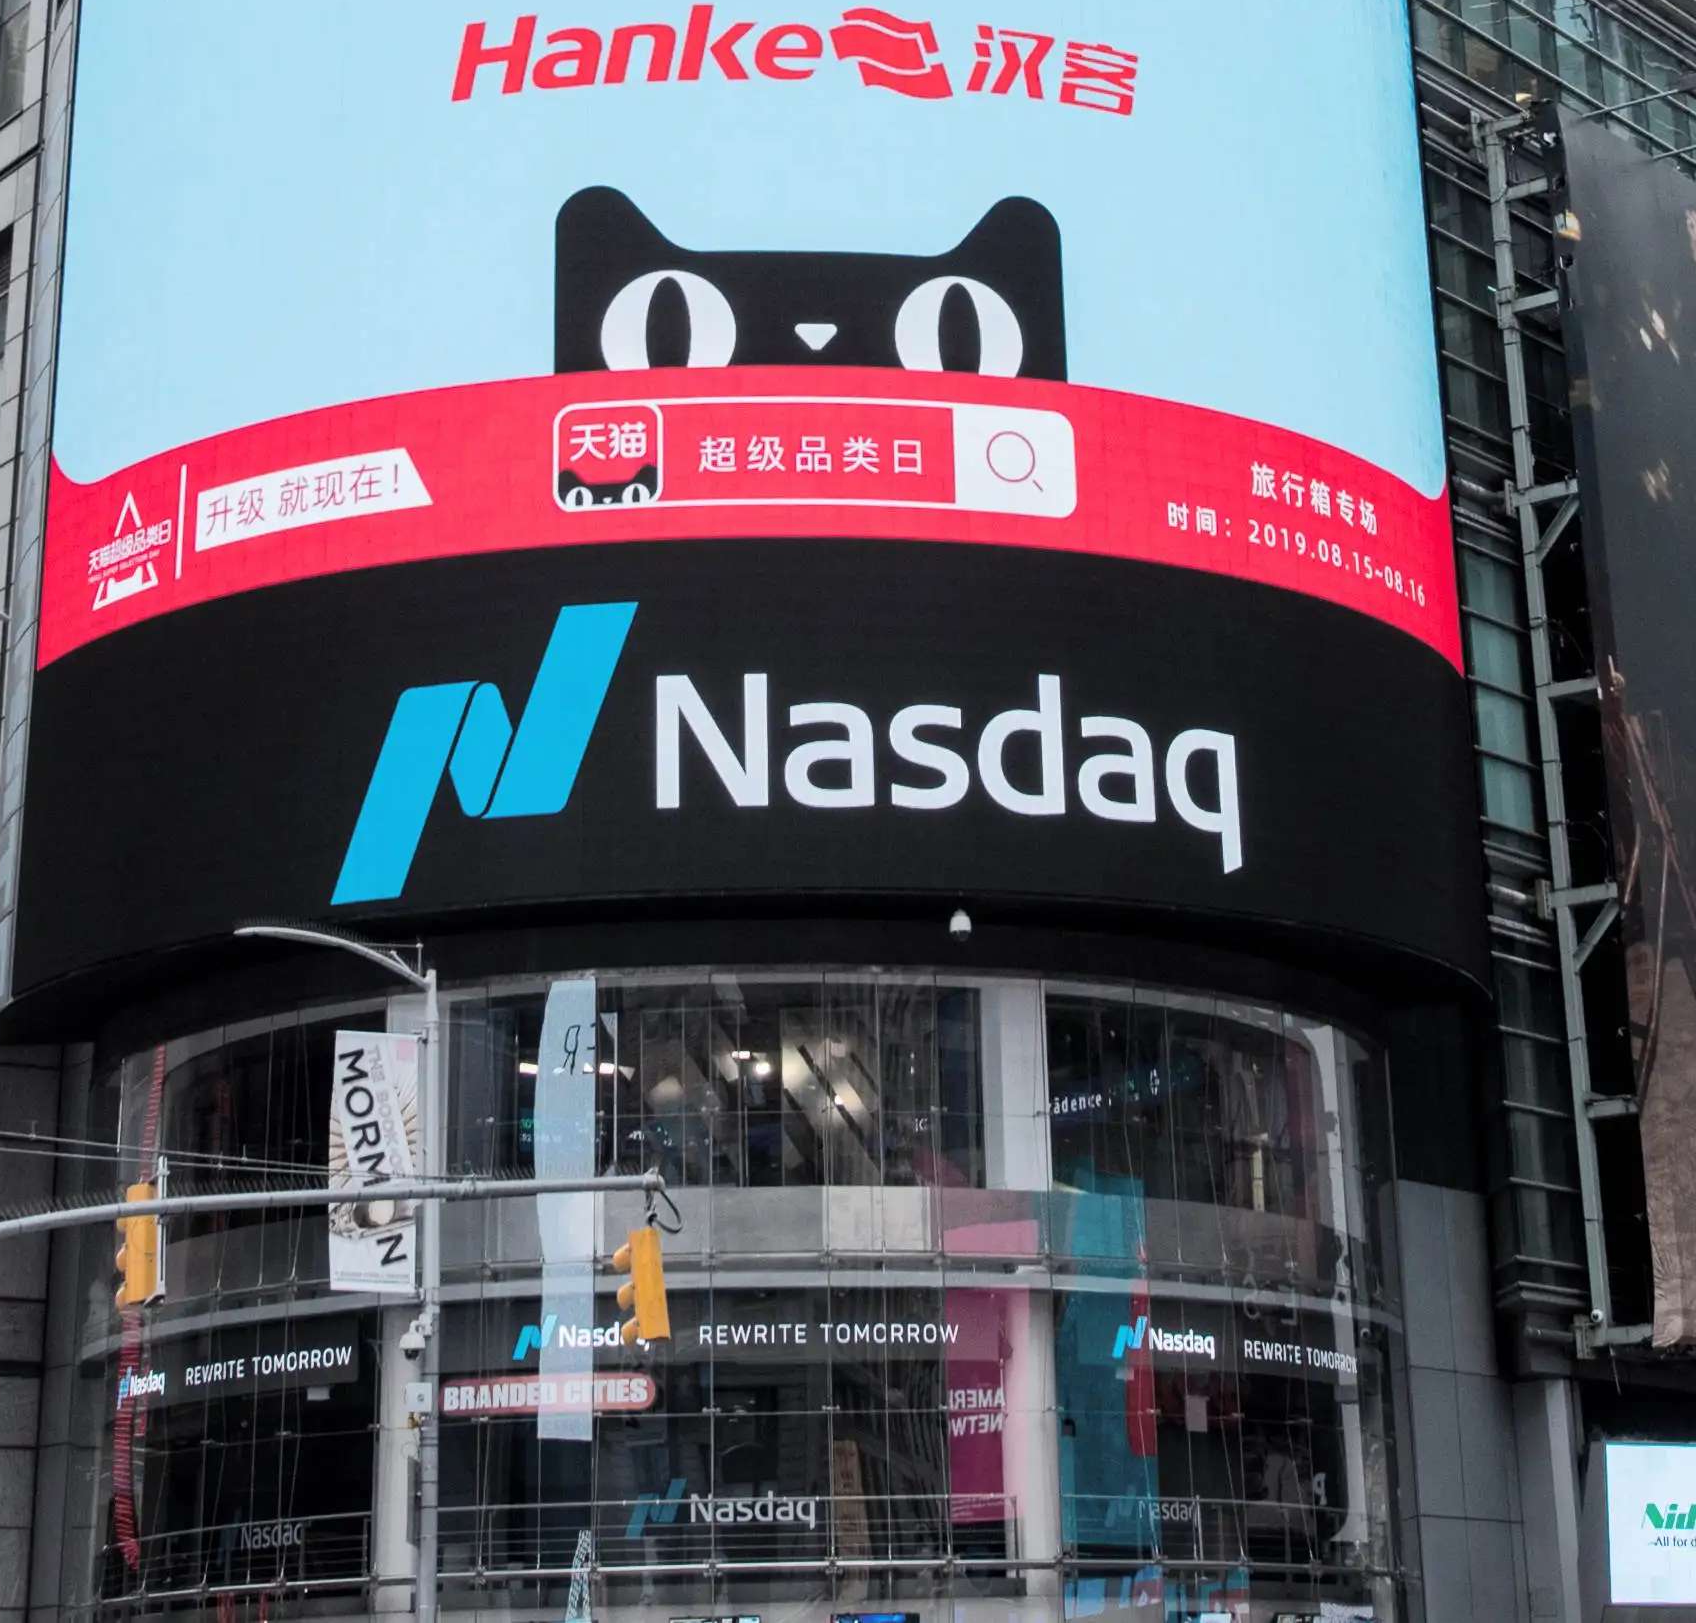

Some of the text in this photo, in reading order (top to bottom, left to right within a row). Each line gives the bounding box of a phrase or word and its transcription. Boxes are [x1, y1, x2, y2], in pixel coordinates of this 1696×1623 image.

[451, 3, 822, 103] Hanke
[965, 24, 1139, 117] 汉客
[569, 421, 647, 462] 天猫
[699, 435, 923, 475] 超级品类日
[206, 488, 265, 537] 升级
[1250, 461, 1378, 535] 旅行箱专场
[655, 673, 1243, 875] Nasdaq
[376, 1088, 398, 1146] BOOK
[699, 1323, 807, 1345] REWRITE
[820, 1323, 958, 1345] TOMORROW
[1149, 1328, 1358, 1374] Nasdaq REWRITE TOMORROW
[130, 1345, 352, 1397] Nasdaq REWRITE TOMORROW
[443, 1378, 648, 1412] BRANDED CITIES
[690, 1490, 816, 1530] Nasdaq
[1654, 1535, 1671, 1548] All
[1672, 1535, 1688, 1548] for
